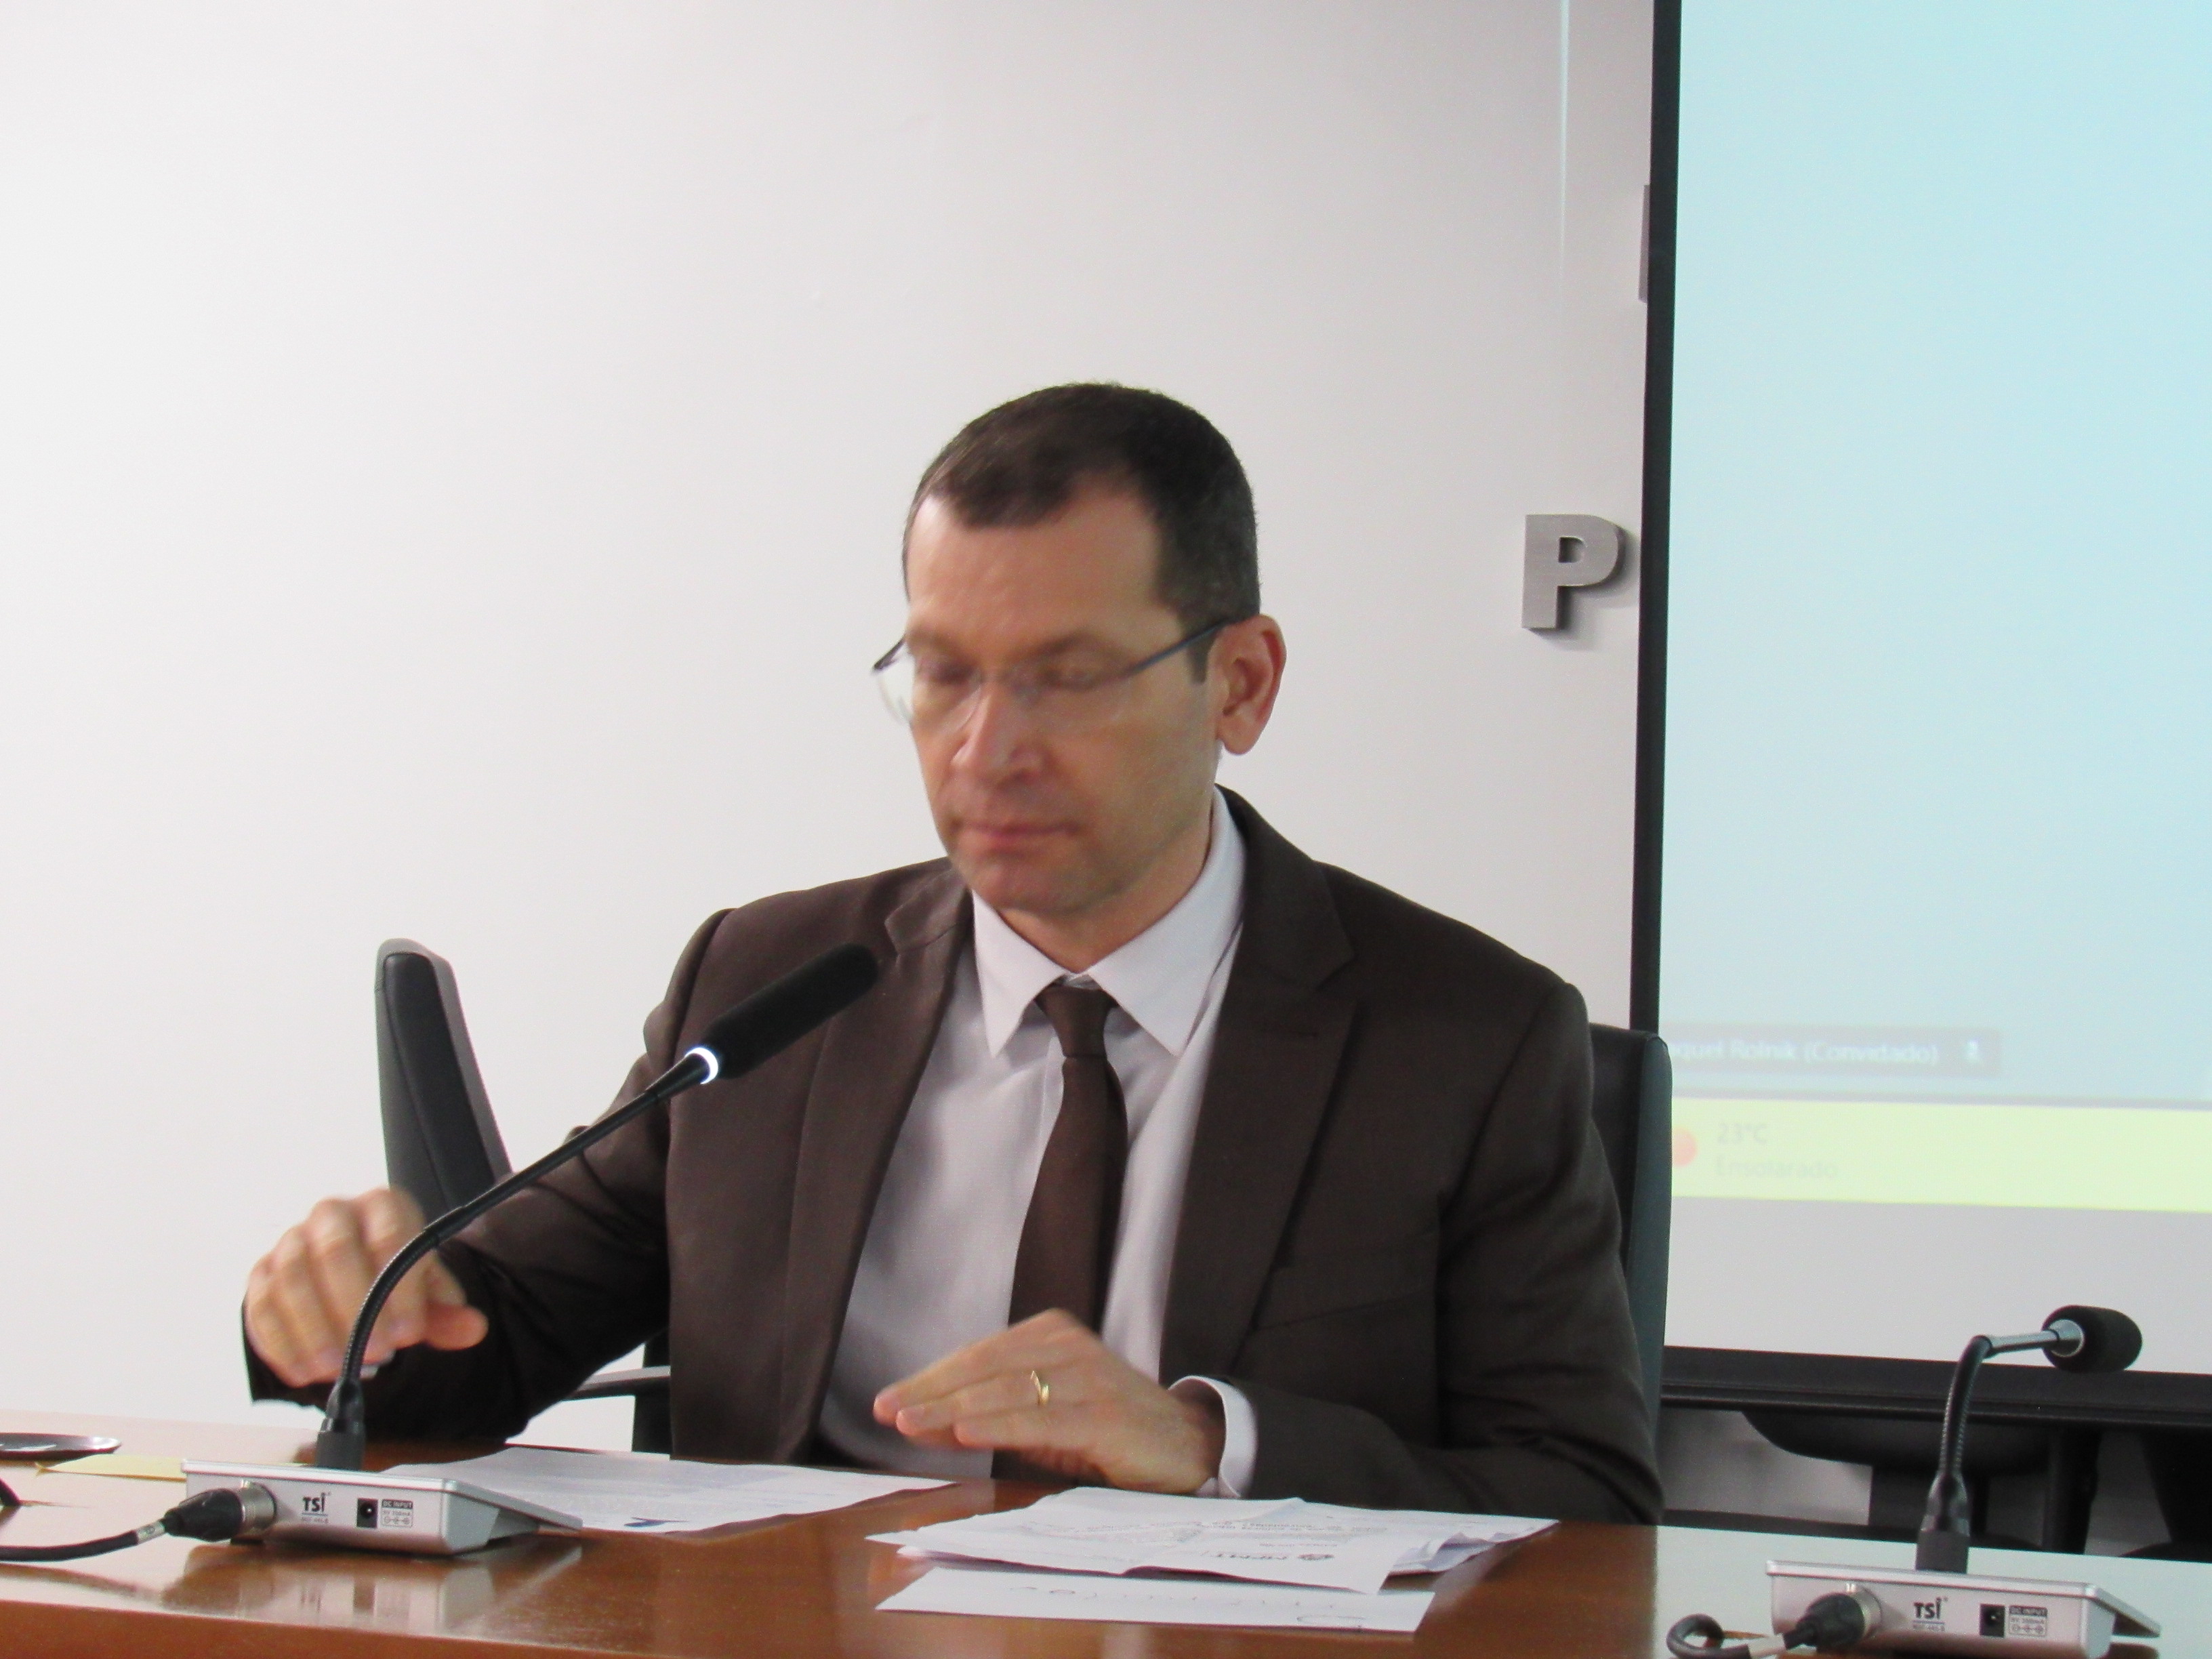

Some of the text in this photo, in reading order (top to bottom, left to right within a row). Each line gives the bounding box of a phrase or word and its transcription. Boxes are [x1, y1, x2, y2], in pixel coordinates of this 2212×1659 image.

[1522, 514, 1626, 630] P
[1729, 1038, 1795, 1061] Rolnik
[1804, 1040, 1938, 1067] (Convidado)
[1717, 1122, 1768, 1146] 23°C
[1715, 1153, 1838, 1179] Ensolarado
